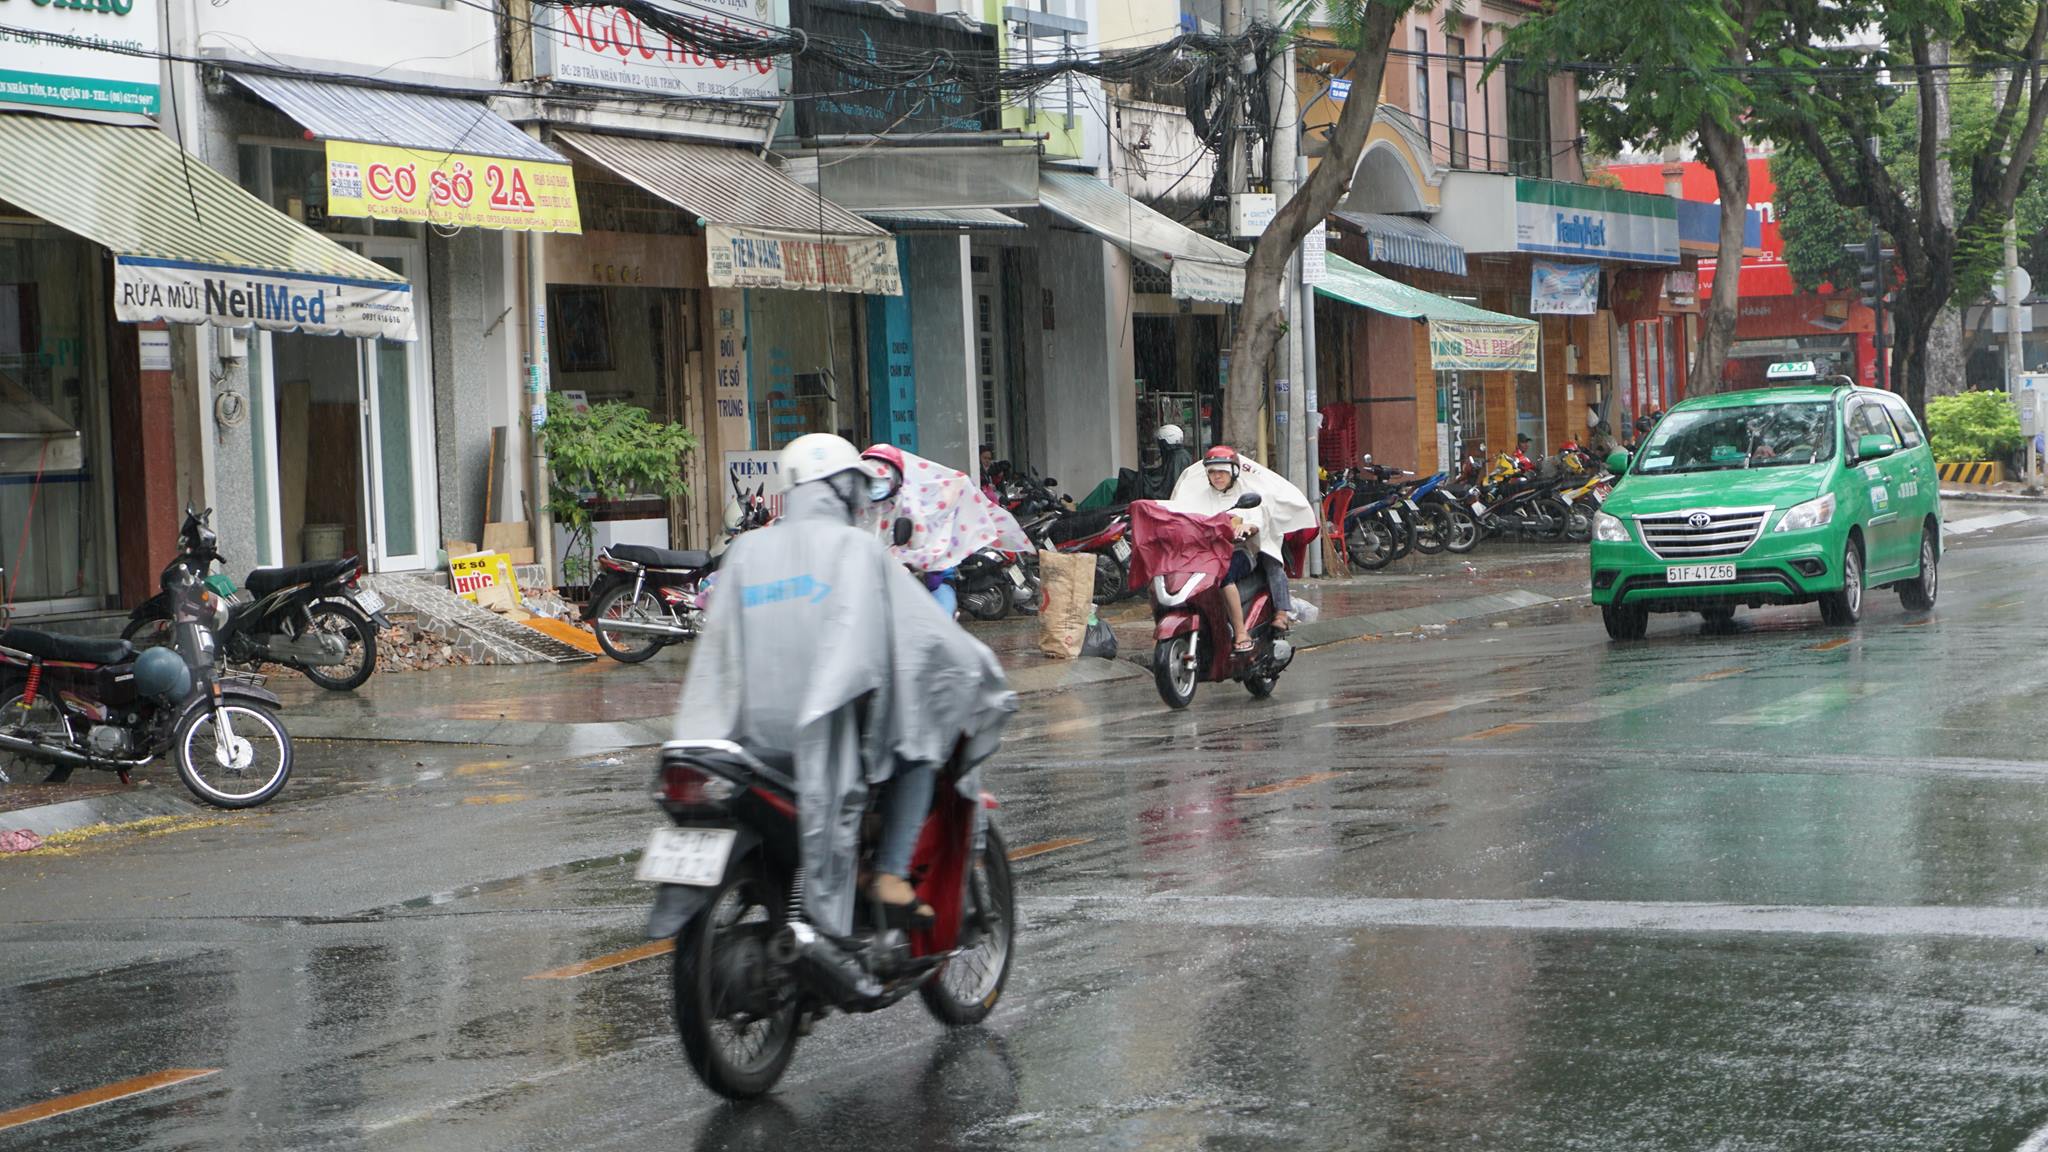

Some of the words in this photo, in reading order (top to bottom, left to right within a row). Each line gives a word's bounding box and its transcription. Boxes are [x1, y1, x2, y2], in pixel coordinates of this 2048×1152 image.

[564, 4, 656, 66] NGỌC
[582, 65, 599, 79] TRẦN
[600, 68, 617, 82] NHÂN
[619, 70, 632, 83] TÔN
[367, 163, 417, 202] CƠ
[430, 162, 474, 208] SỞ
[485, 165, 535, 212] 2A
[124, 277, 161, 306] RỬA
[168, 280, 198, 310] MŨI
[204, 278, 325, 324] NeilMed
[718, 395, 744, 417] TRÚNG
[730, 458, 768, 479] TIỆM
